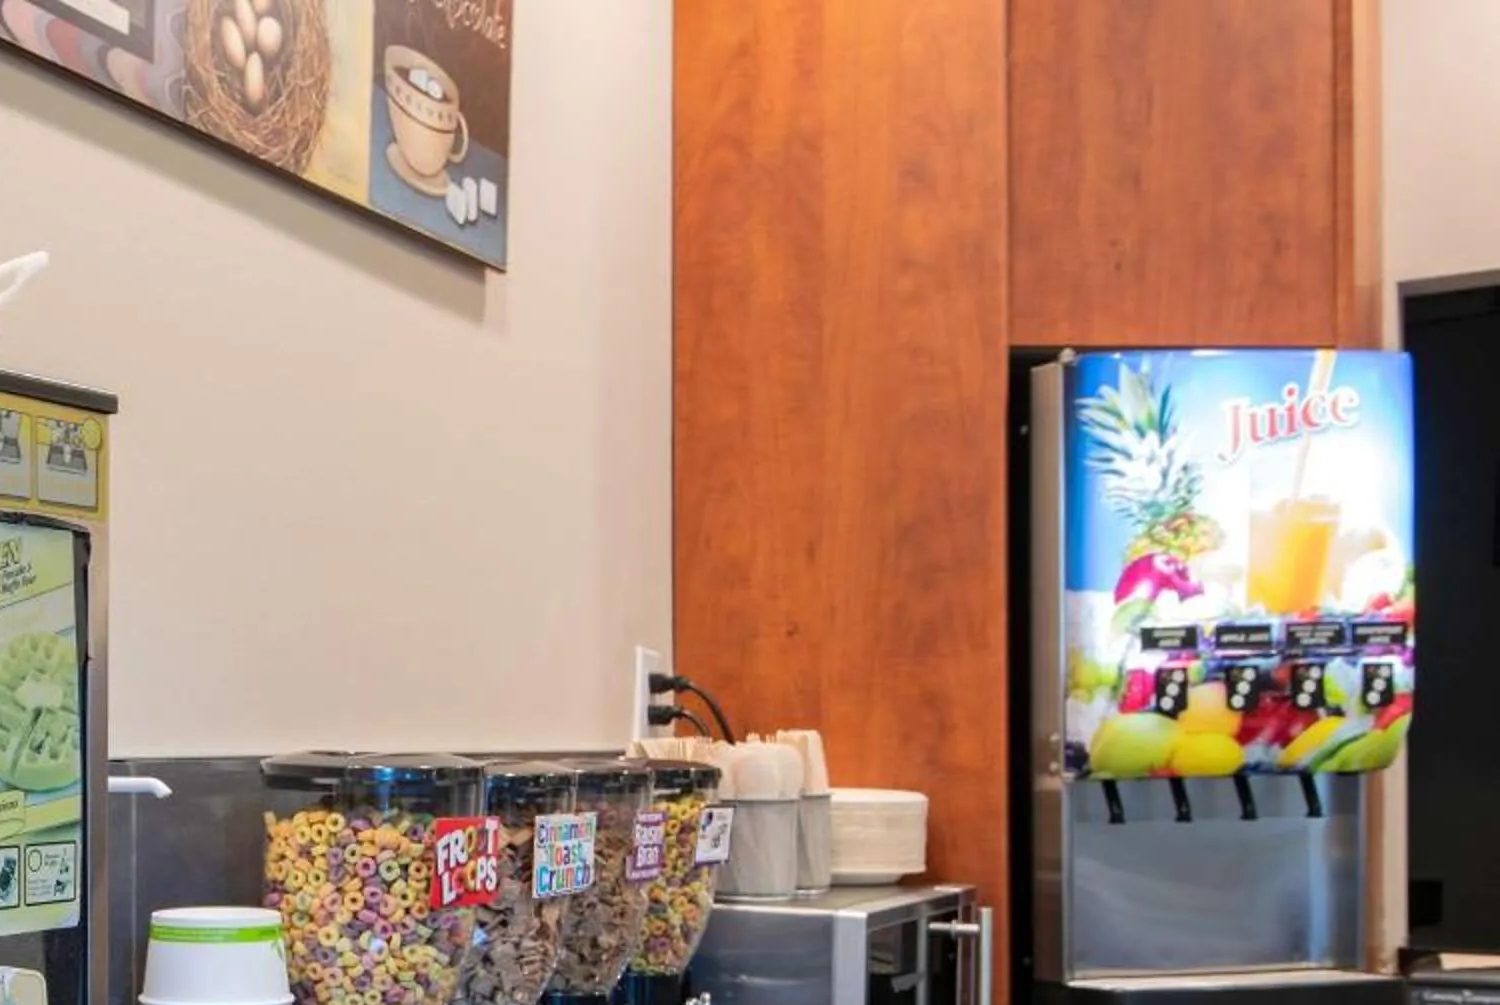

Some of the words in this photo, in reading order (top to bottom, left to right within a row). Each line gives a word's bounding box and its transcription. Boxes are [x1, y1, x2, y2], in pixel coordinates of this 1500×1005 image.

[1218, 385, 1358, 464] Juice
[437, 818, 499, 876] FROOT
[545, 841, 585, 867] Toast
[442, 855, 498, 905] LOOPS
[536, 858, 591, 896] Crunch
